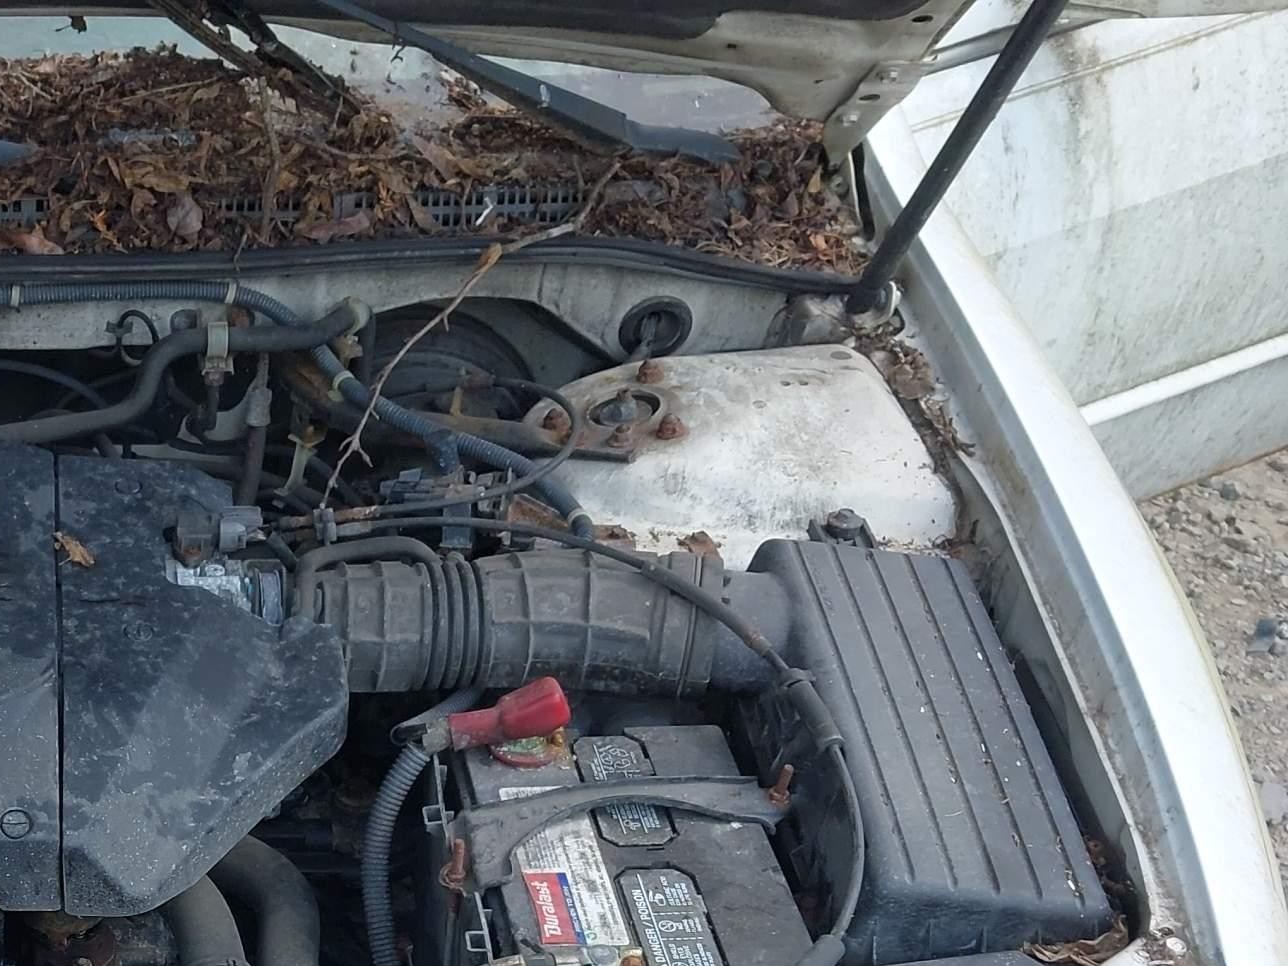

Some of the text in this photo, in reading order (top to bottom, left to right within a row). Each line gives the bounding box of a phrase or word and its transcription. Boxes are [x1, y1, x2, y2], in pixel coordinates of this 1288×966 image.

[530, 880, 562, 938] Duralast
[631, 889, 651, 921] POISON
[644, 928, 667, 963] DANGER
